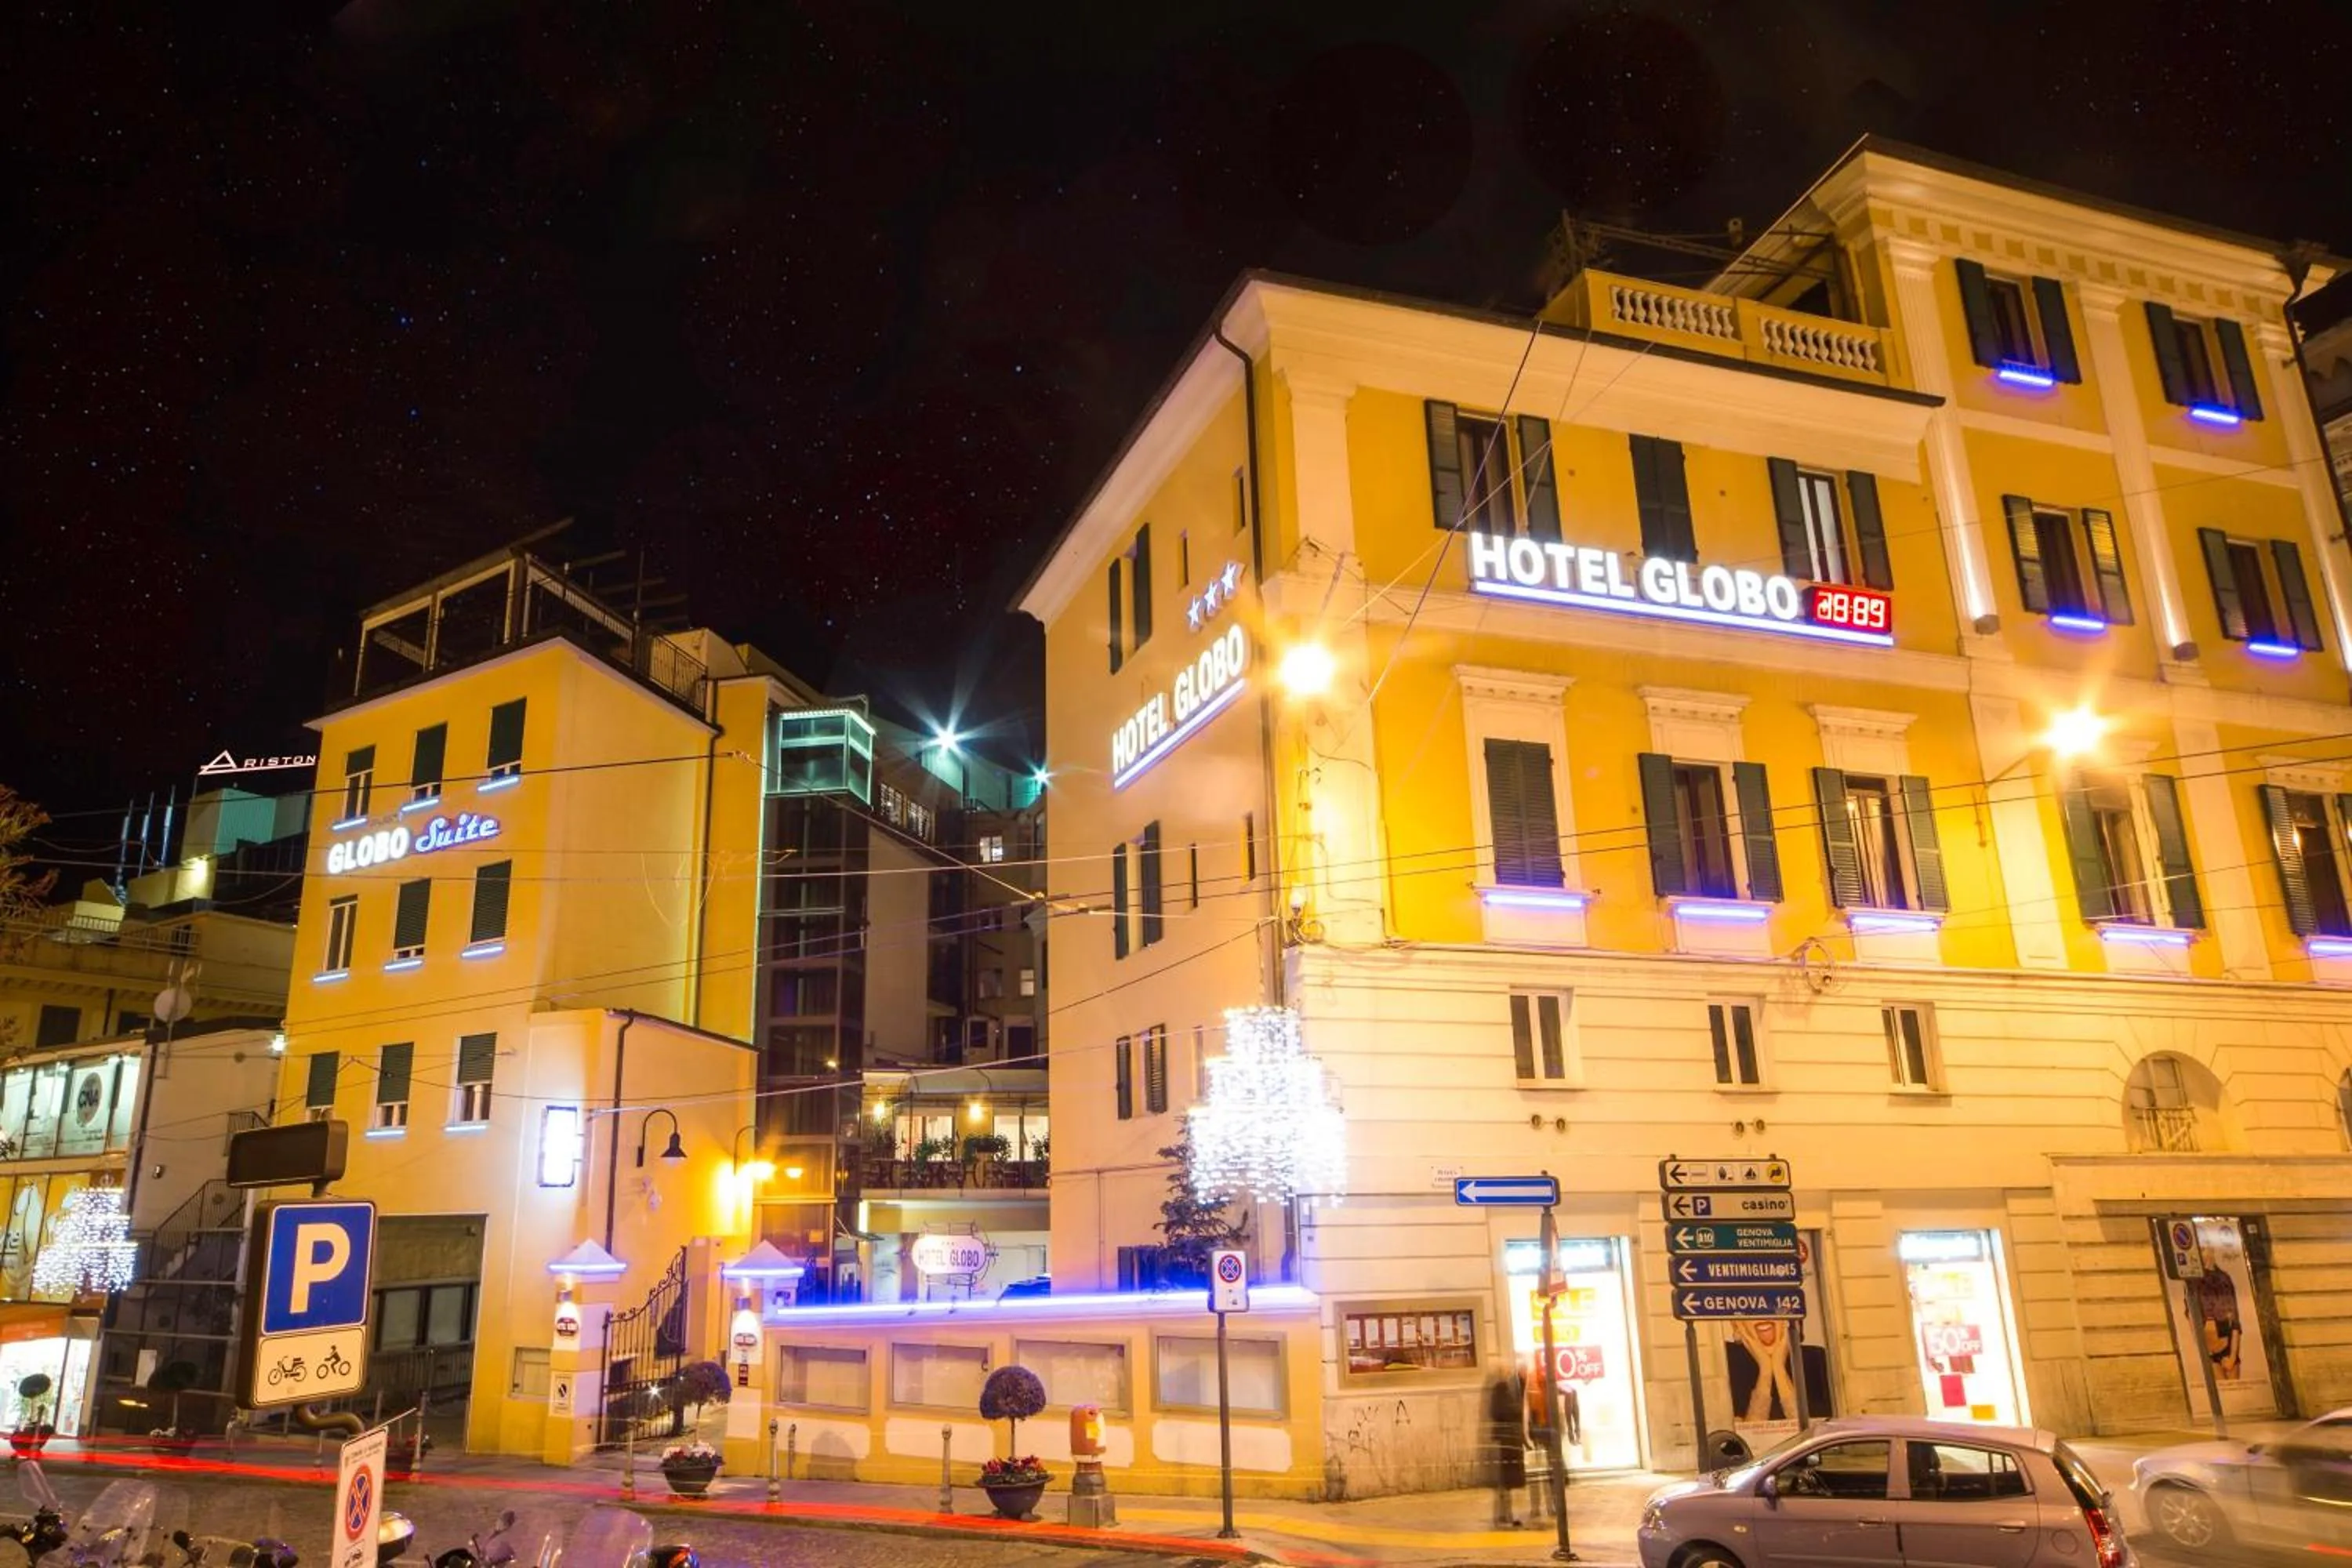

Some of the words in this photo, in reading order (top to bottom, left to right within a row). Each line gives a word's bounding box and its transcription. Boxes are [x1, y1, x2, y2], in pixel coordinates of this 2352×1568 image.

[1470, 532, 1635, 598] HOTEL
[1641, 557, 1798, 620] GLOBO
[1112, 691, 1169, 774] HOTEL
[1174, 624, 1244, 720] GLOBO
[198, 750, 317, 775] ARISTON
[327, 827, 410, 874] GLOBO
[415, 812, 499, 853] Suite
[1696, 1199, 1708, 1214] P
[1736, 1228, 1774, 1237] GENOVA
[1737, 1238, 1794, 1248] VENTIMIGLIA
[949, 1248, 979, 1267] GLOBO
[289, 1222, 351, 1315] P
[1708, 1262, 1777, 1277] VENTIMIGLIA
[1704, 1295, 1768, 1310] GENOVA
[1776, 1295, 1801, 1309] 142
[1577, 1364, 1600, 1375] OFF
